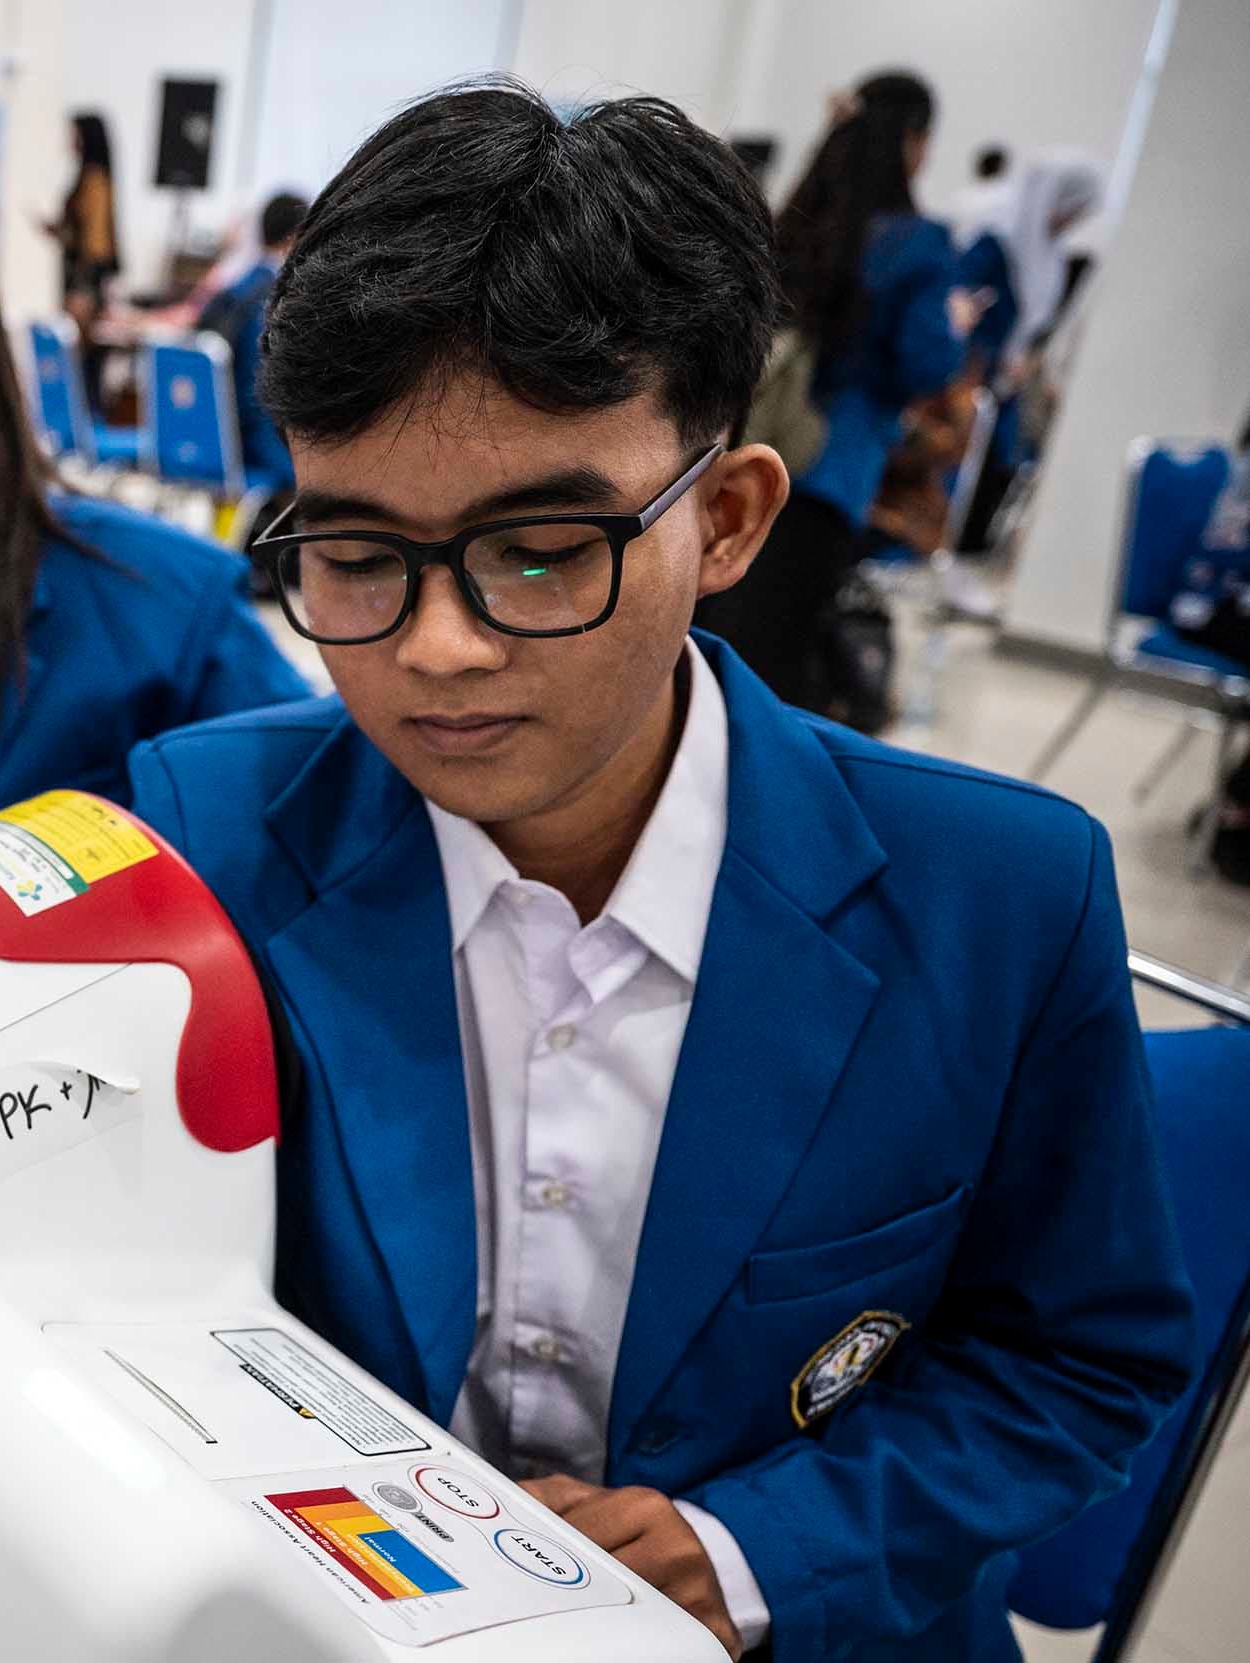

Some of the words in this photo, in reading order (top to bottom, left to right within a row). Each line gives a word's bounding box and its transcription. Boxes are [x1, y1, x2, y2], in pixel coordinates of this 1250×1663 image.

[437, 1477, 480, 1508] STOP
[251, 1500, 302, 1544] Association
[292, 1514, 316, 1536] Stage
[415, 1511, 450, 1540] PRINT
[316, 1535, 336, 1553] High
[323, 1527, 347, 1548] Stage
[364, 1536, 398, 1563] Normal
[299, 1545, 326, 1566] Heart
[347, 1547, 369, 1566] High
[511, 1535, 567, 1576] START
[326, 1568, 370, 1604] American
